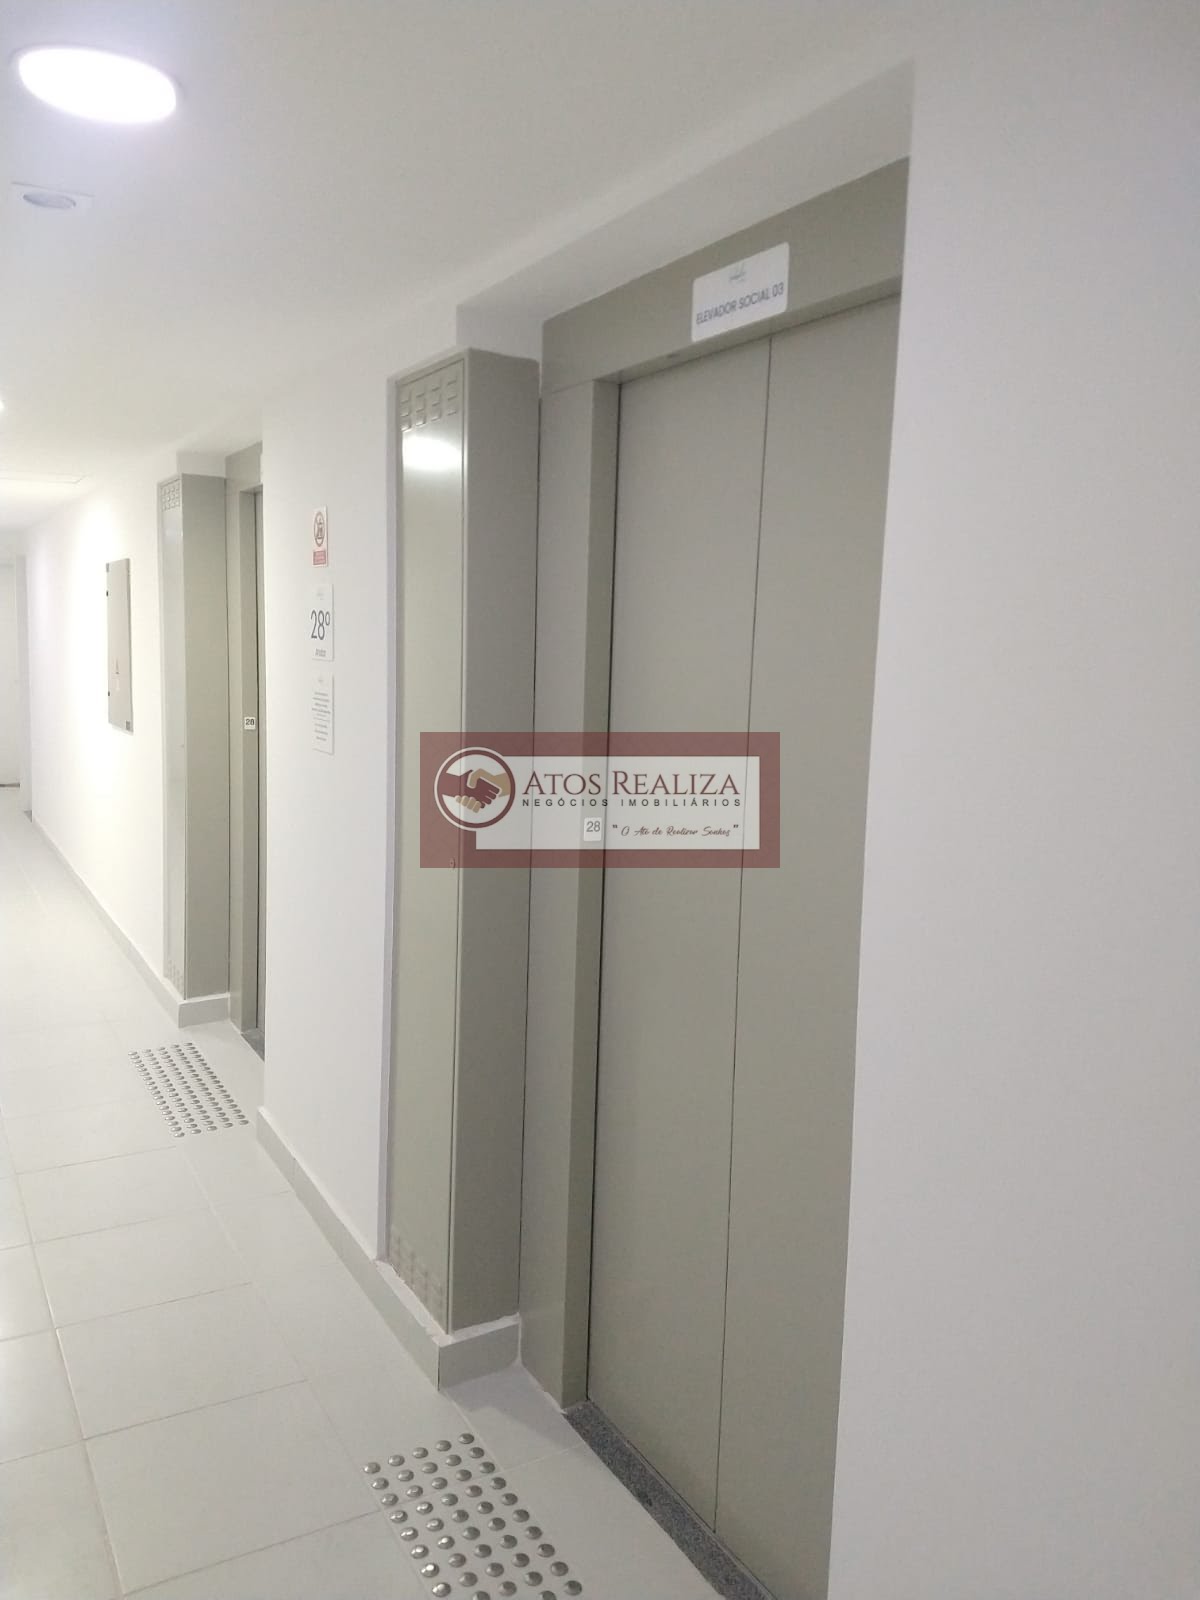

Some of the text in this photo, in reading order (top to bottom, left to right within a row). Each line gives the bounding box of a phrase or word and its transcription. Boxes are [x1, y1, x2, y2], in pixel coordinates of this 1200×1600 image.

[696, 281, 784, 325] ELEVADOR SOCIAL 03
[586, 820, 601, 833] 28
